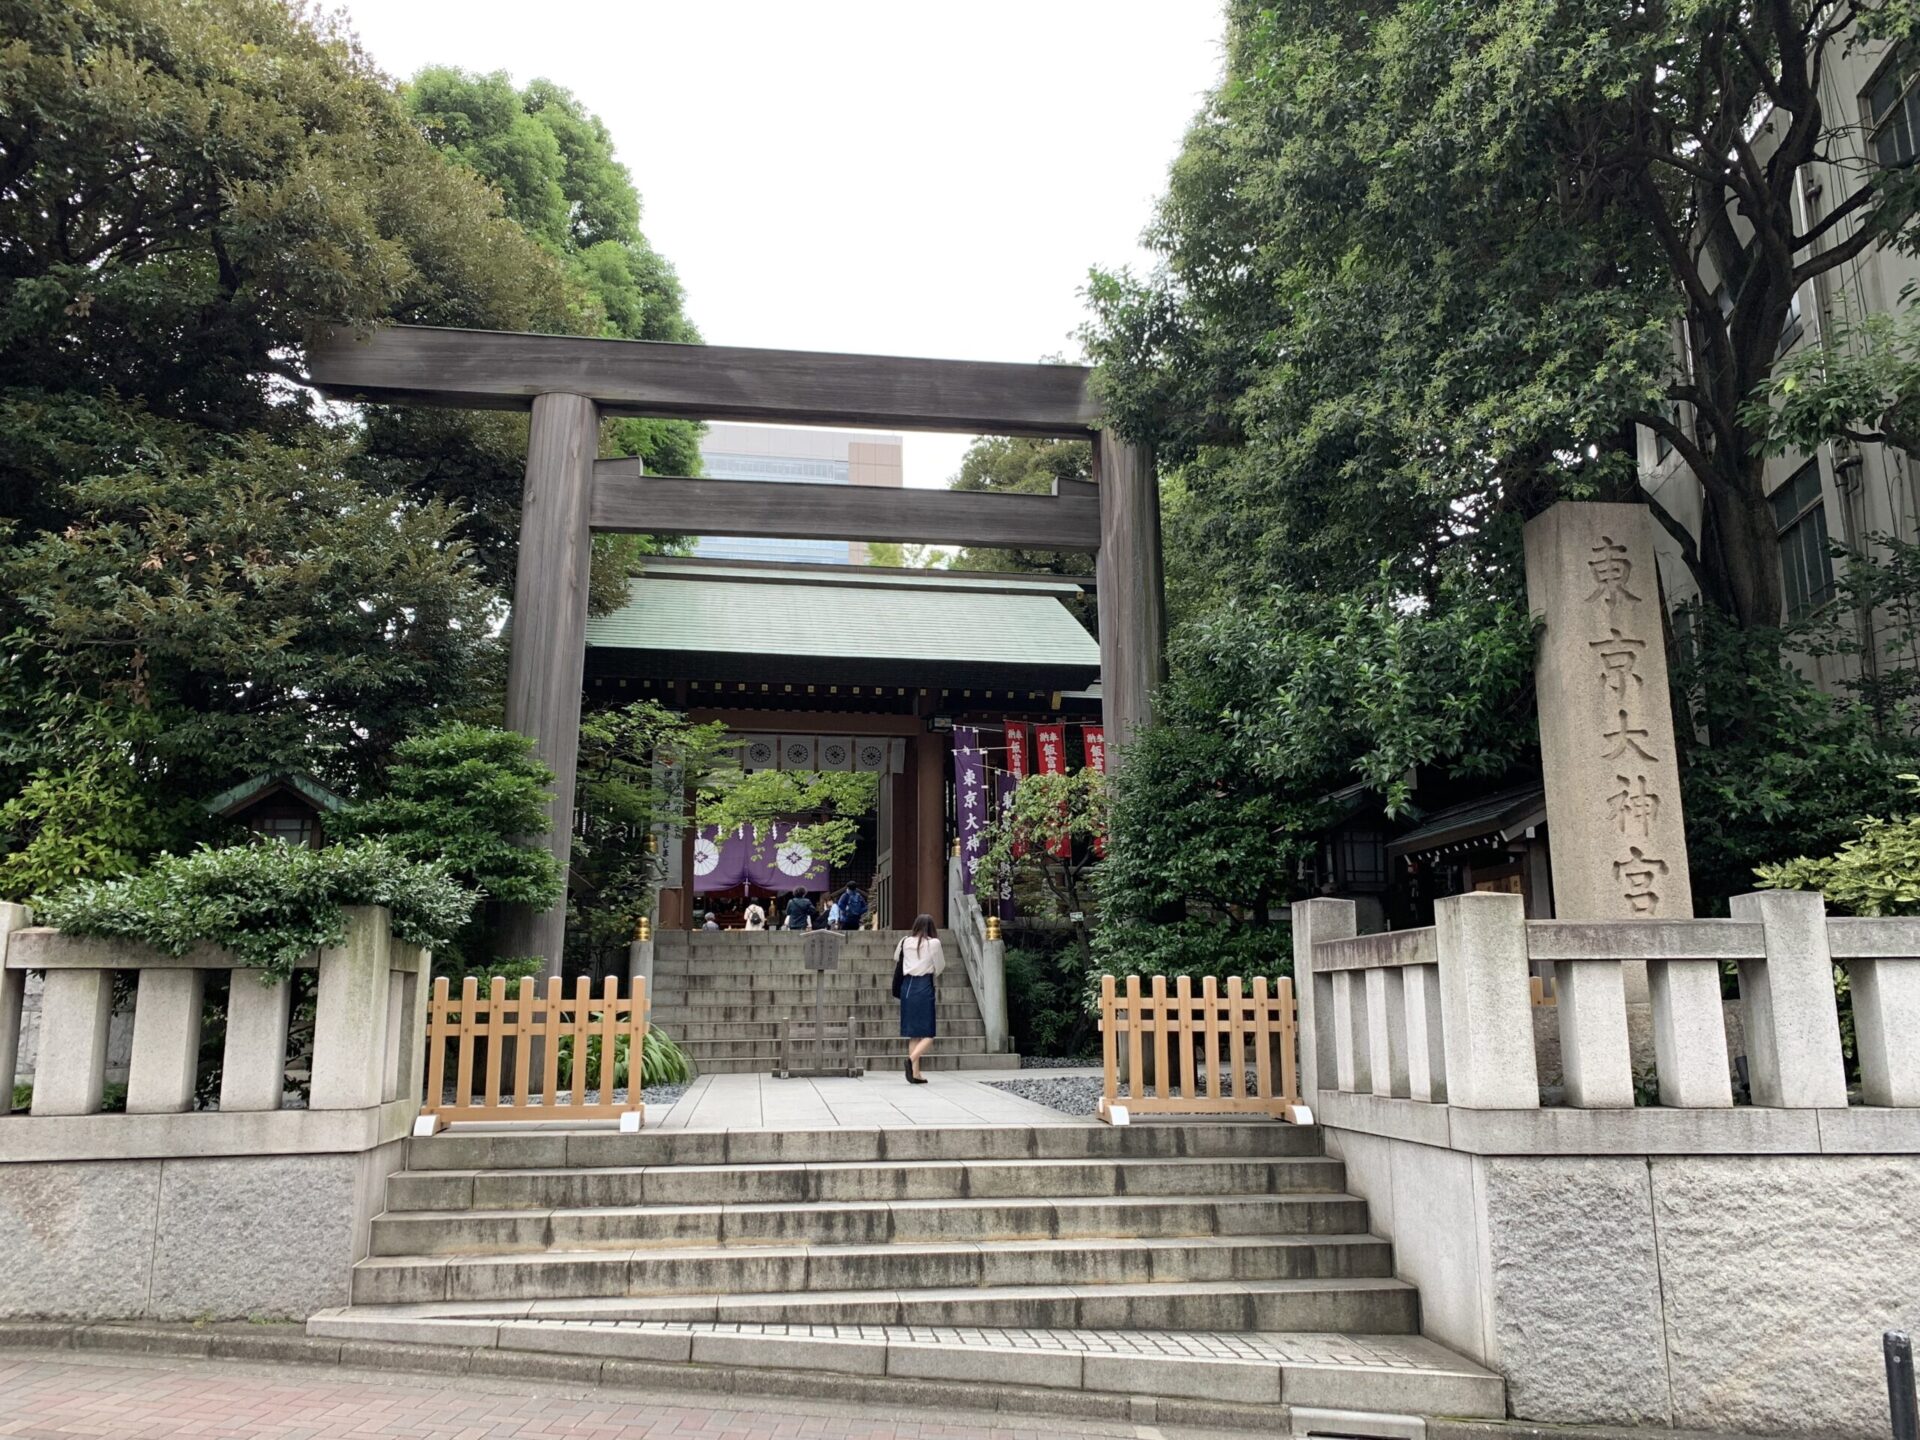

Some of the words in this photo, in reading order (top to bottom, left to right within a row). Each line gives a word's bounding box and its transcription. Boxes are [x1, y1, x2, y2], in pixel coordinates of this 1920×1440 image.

[963, 769, 980, 875] 東京大神宮
[1584, 535, 1669, 914] 東京大神宮
